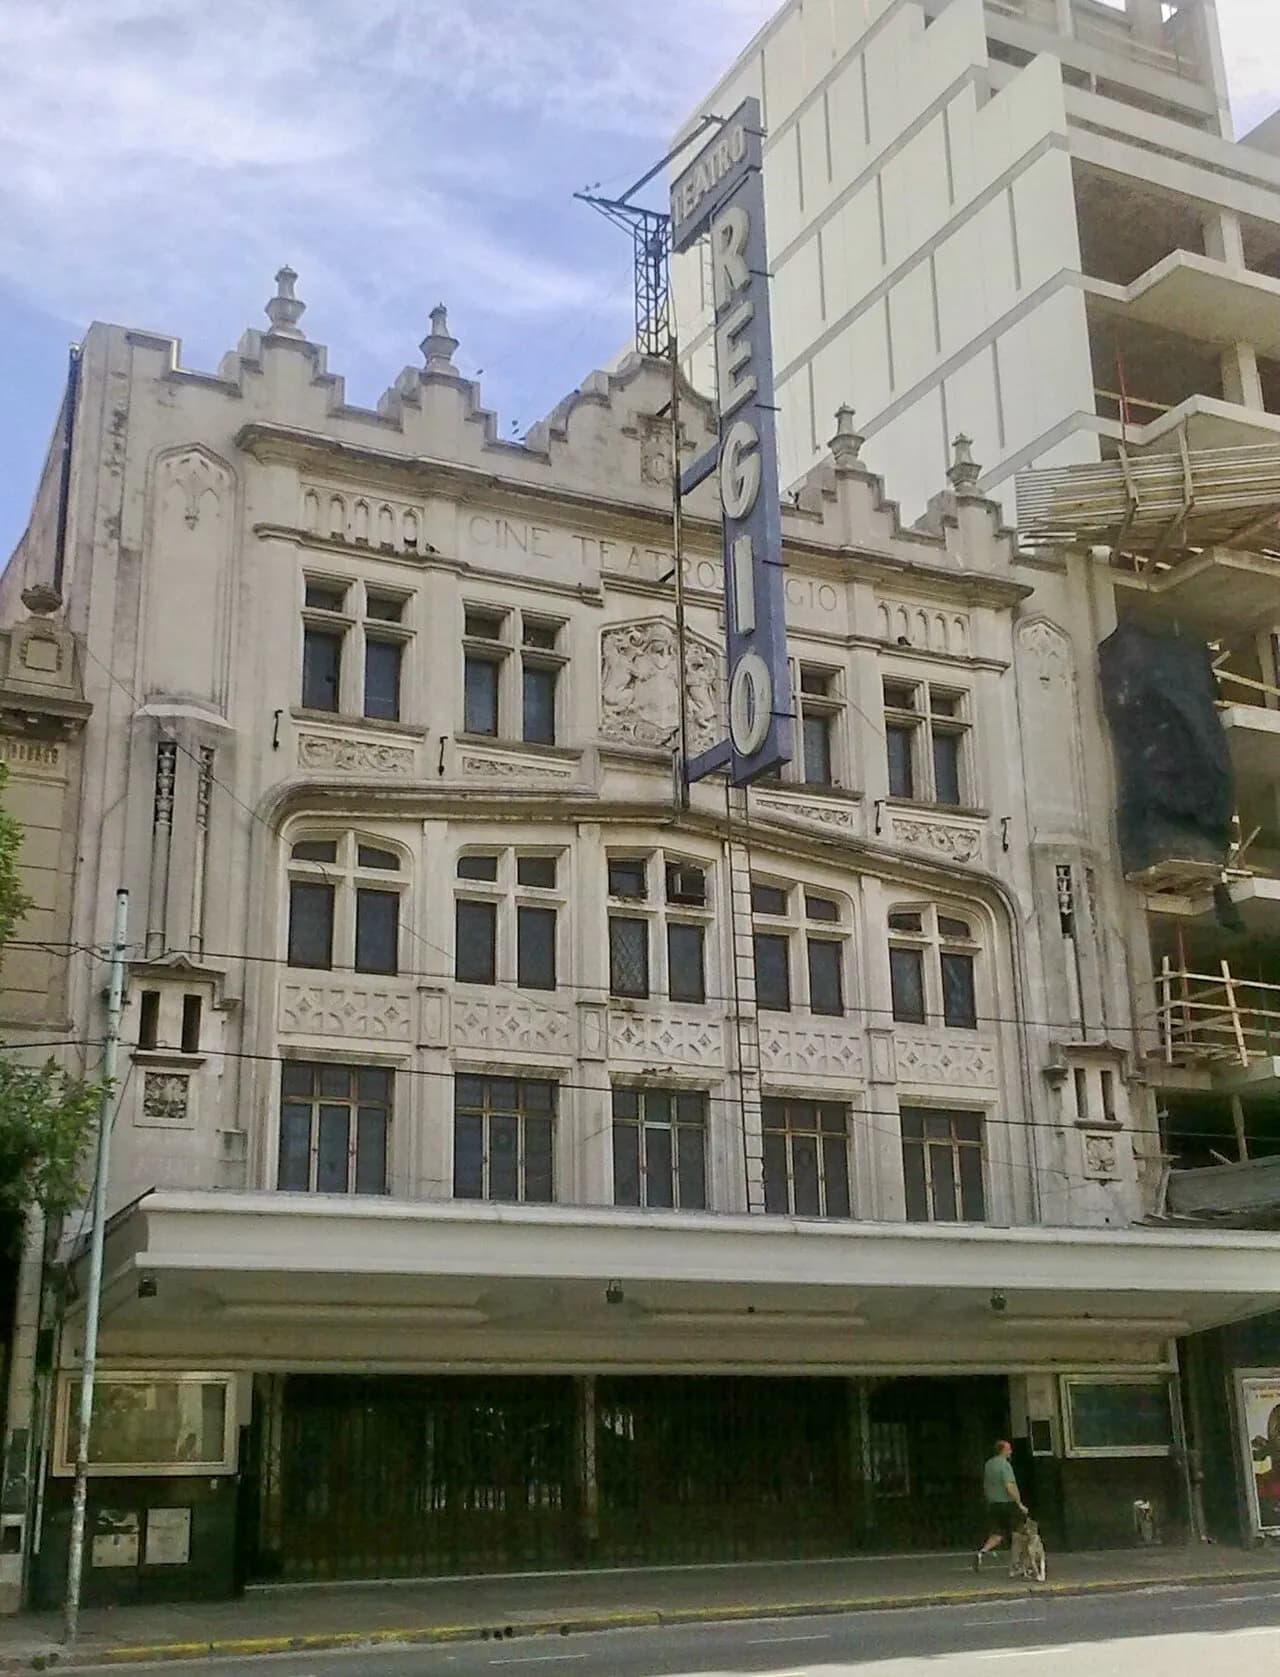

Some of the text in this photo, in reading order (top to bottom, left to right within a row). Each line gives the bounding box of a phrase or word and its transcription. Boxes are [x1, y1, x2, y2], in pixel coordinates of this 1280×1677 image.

[673, 125, 746, 227] TEATRO
[710, 206, 772, 758] REGIO
[468, 516, 552, 558] CINE
[786, 578, 838, 612] GIO
